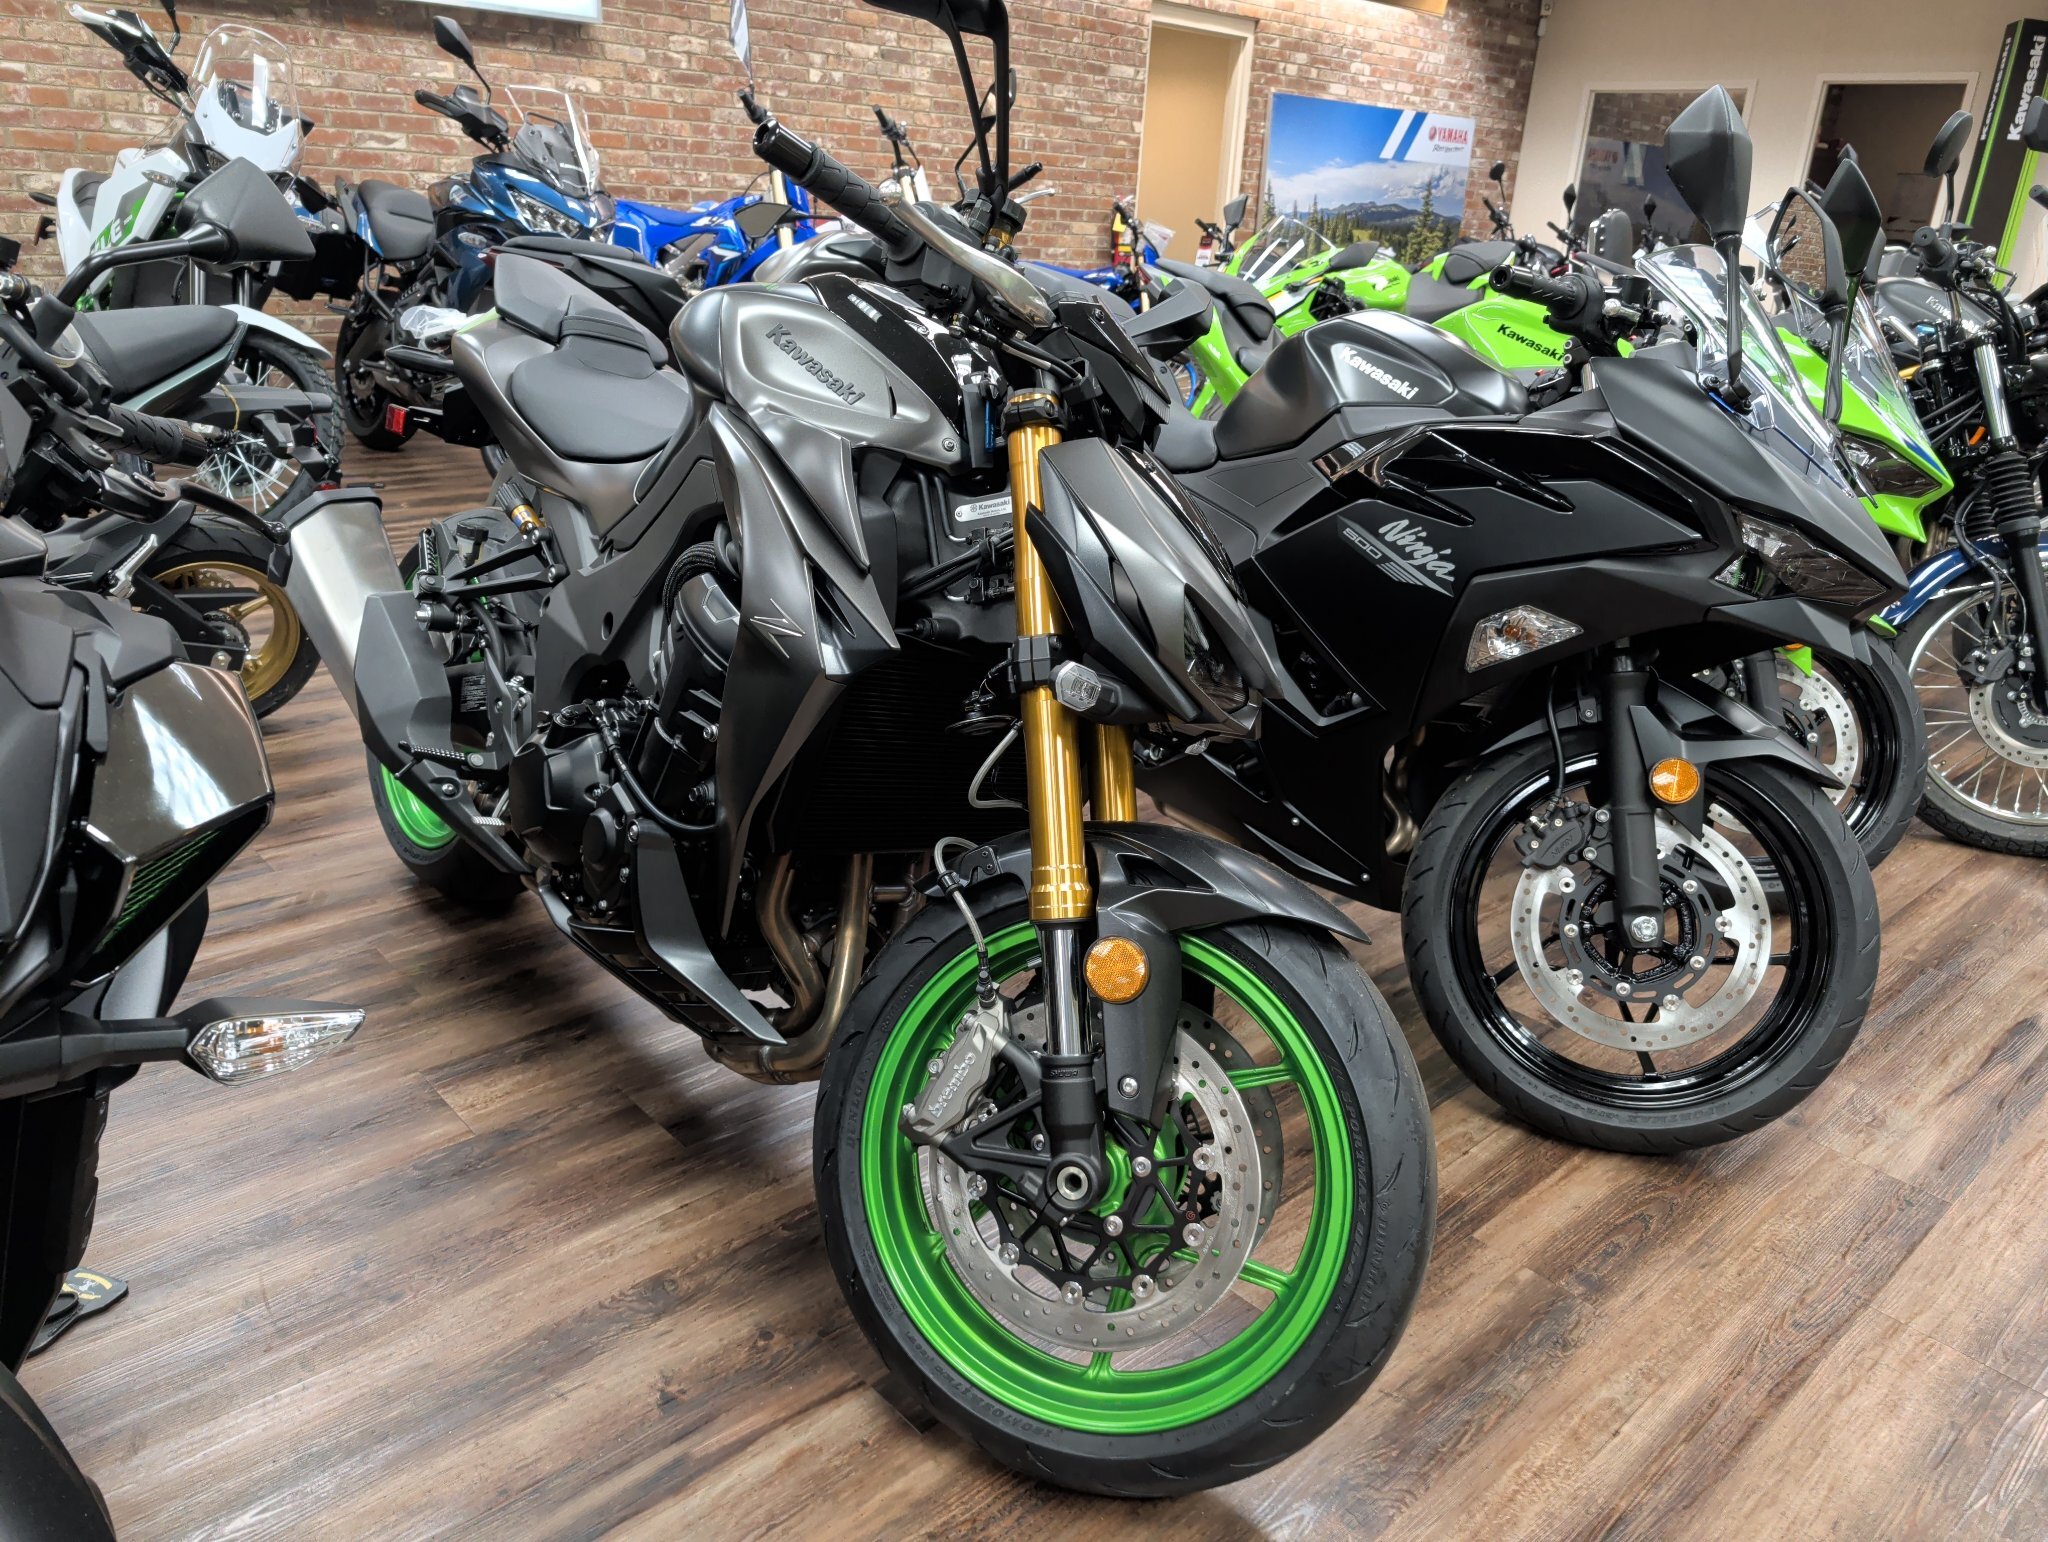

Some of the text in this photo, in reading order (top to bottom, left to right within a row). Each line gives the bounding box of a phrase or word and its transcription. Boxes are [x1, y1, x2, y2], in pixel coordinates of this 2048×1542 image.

[2006, 35, 2047, 140] Kawasaki
[1437, 127, 1468, 145] YAMAHA
[765, 322, 866, 406] Kawasaki
[1338, 346, 1419, 400] Kawasaki
[1497, 323, 1565, 362] Kawasaki
[978, 498, 1010, 511] Kawasaki
[1378, 519, 1456, 582] Ninja
[928, 1051, 977, 1118] brembo
[1341, 1088, 1369, 1217] SPORTMAX
